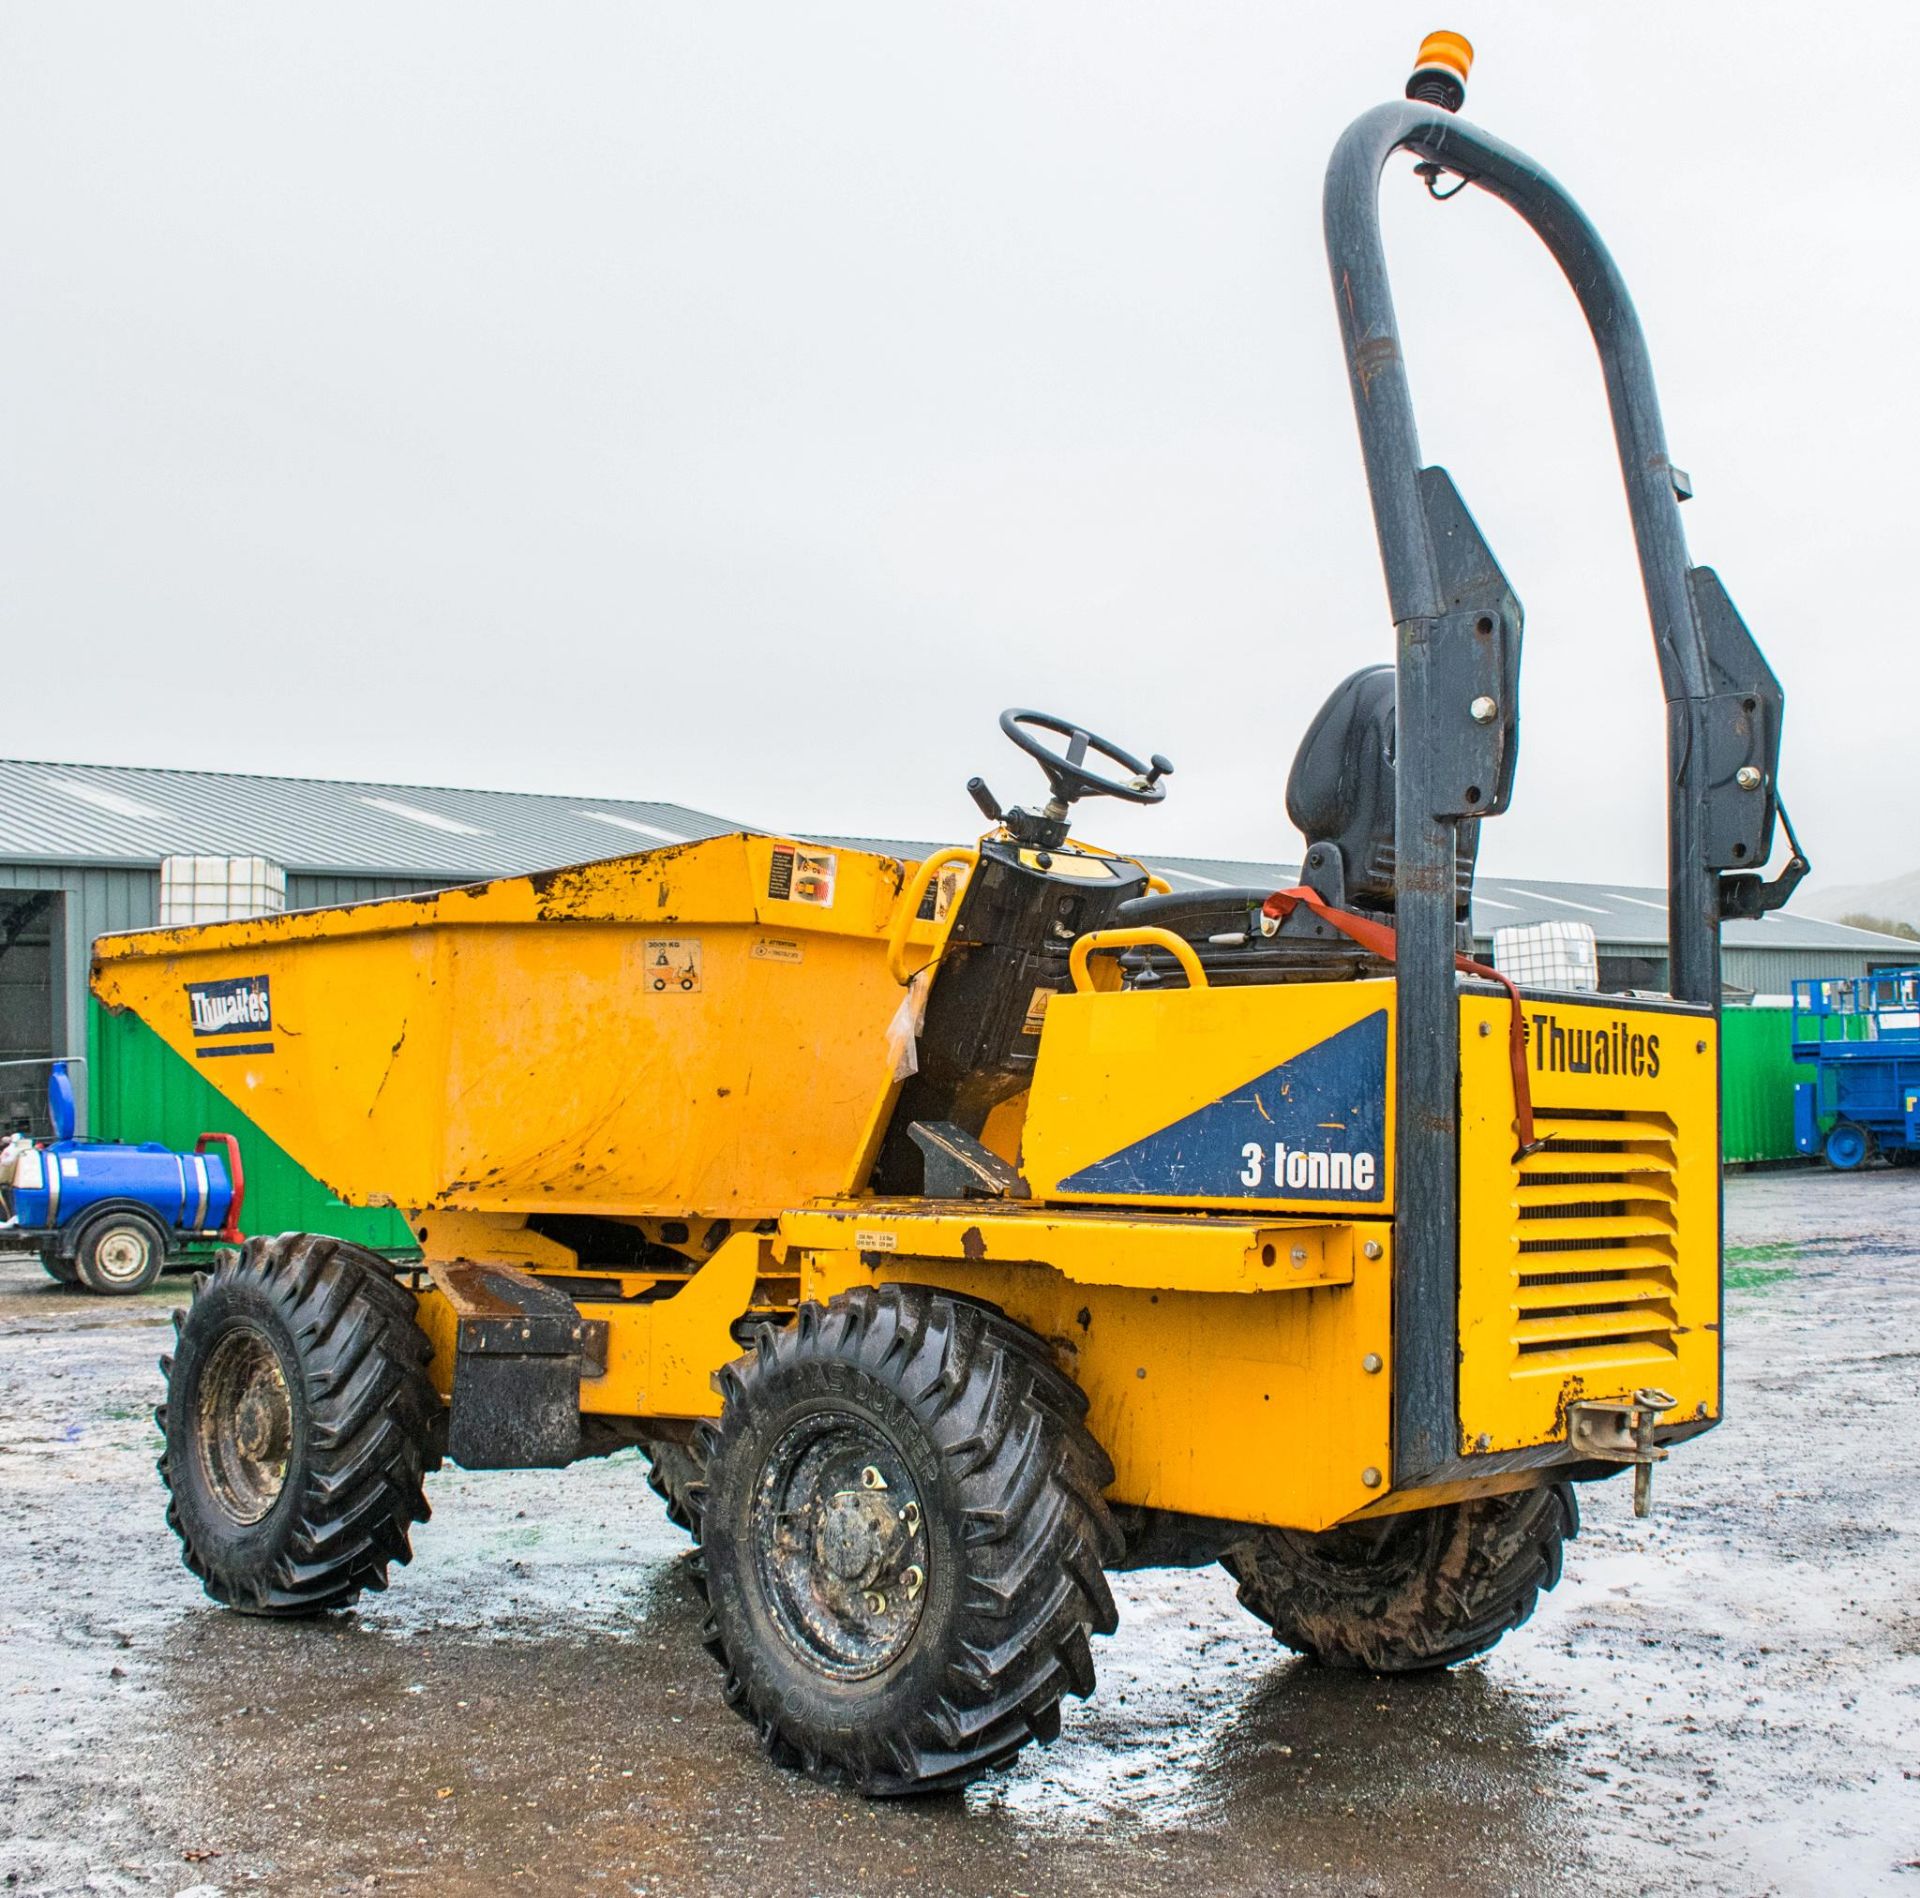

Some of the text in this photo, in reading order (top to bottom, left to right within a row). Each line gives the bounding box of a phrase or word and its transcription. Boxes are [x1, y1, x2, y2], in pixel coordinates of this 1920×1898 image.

[191, 987, 269, 1026] Thwaites
[1532, 1014, 1660, 1078] Thwaites
[1241, 1142, 1376, 1191] 3 tonne
[855, 1369, 938, 1486] DUMPER
